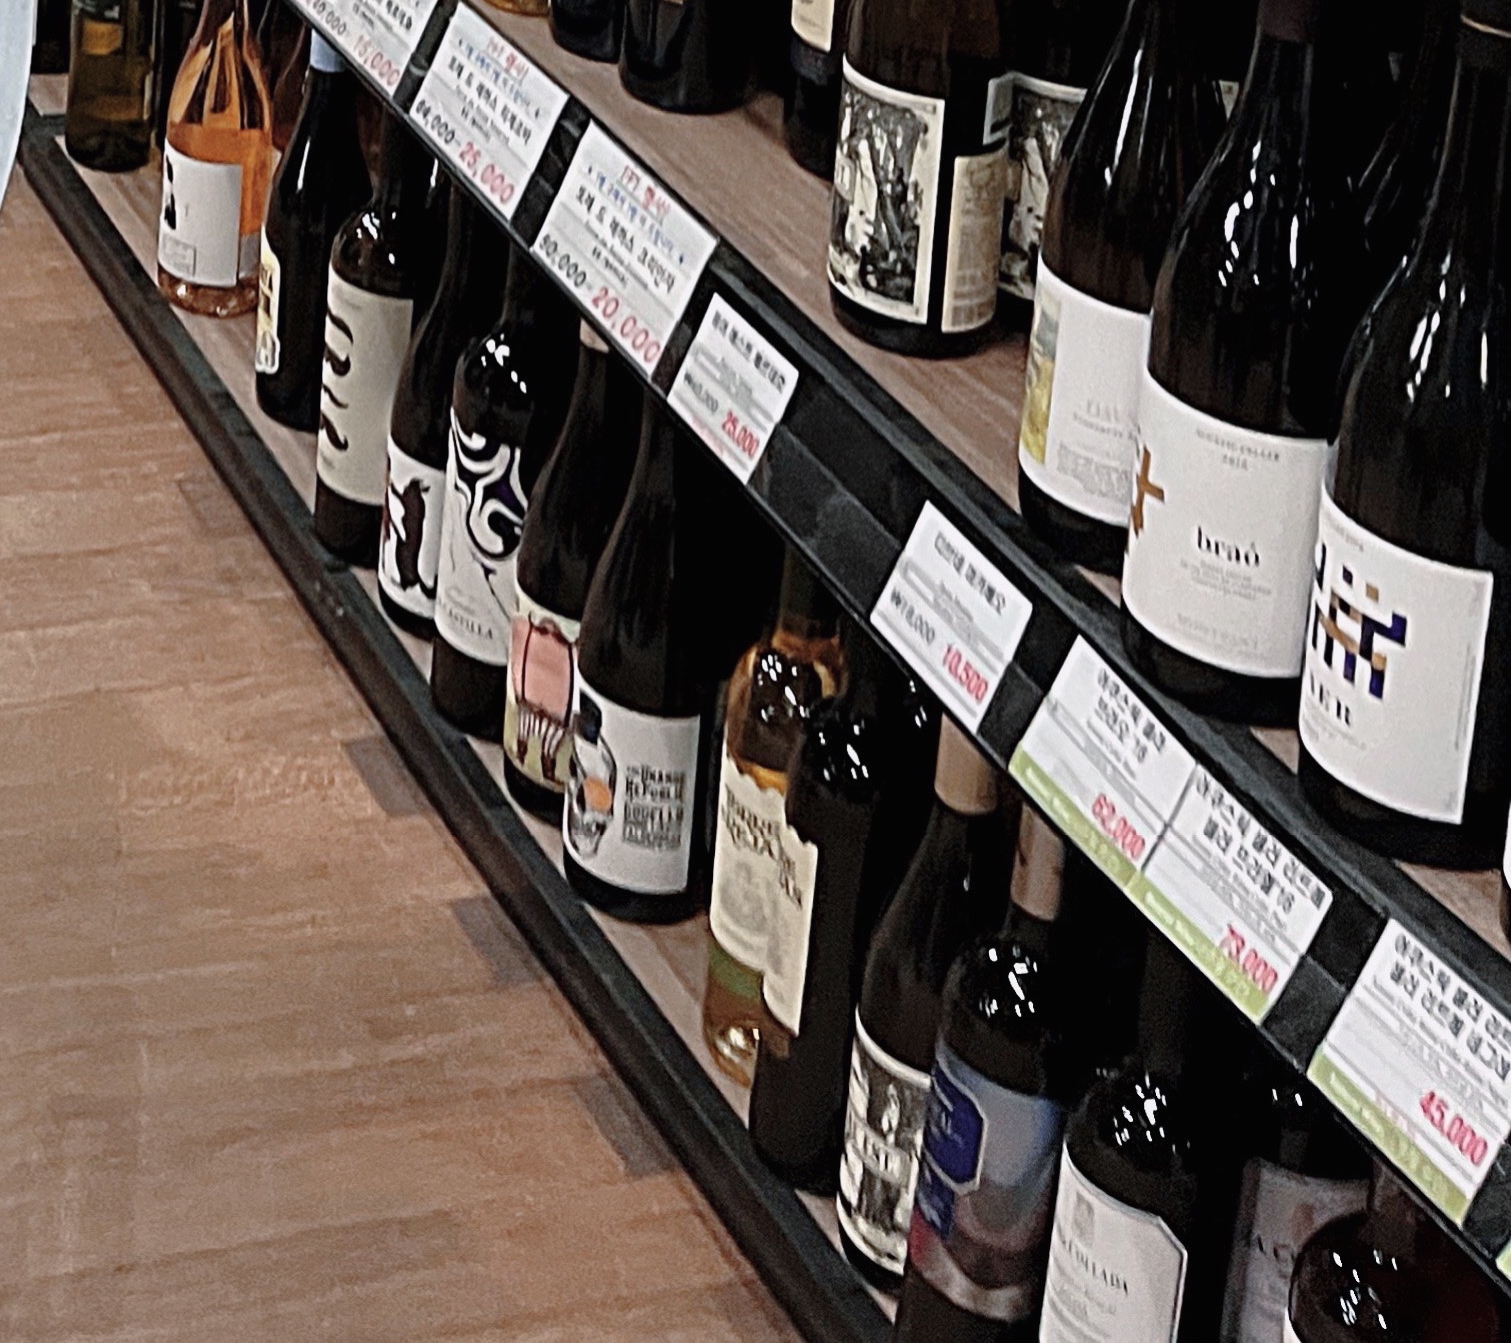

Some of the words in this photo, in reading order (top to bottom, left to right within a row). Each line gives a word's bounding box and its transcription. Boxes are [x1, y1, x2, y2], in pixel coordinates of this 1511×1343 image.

[458, 138, 515, 208] 25,000
[589, 280, 664, 371] 20,000
[940, 641, 990, 705] 10.500
[1414, 1085, 1492, 1169] 45.000
